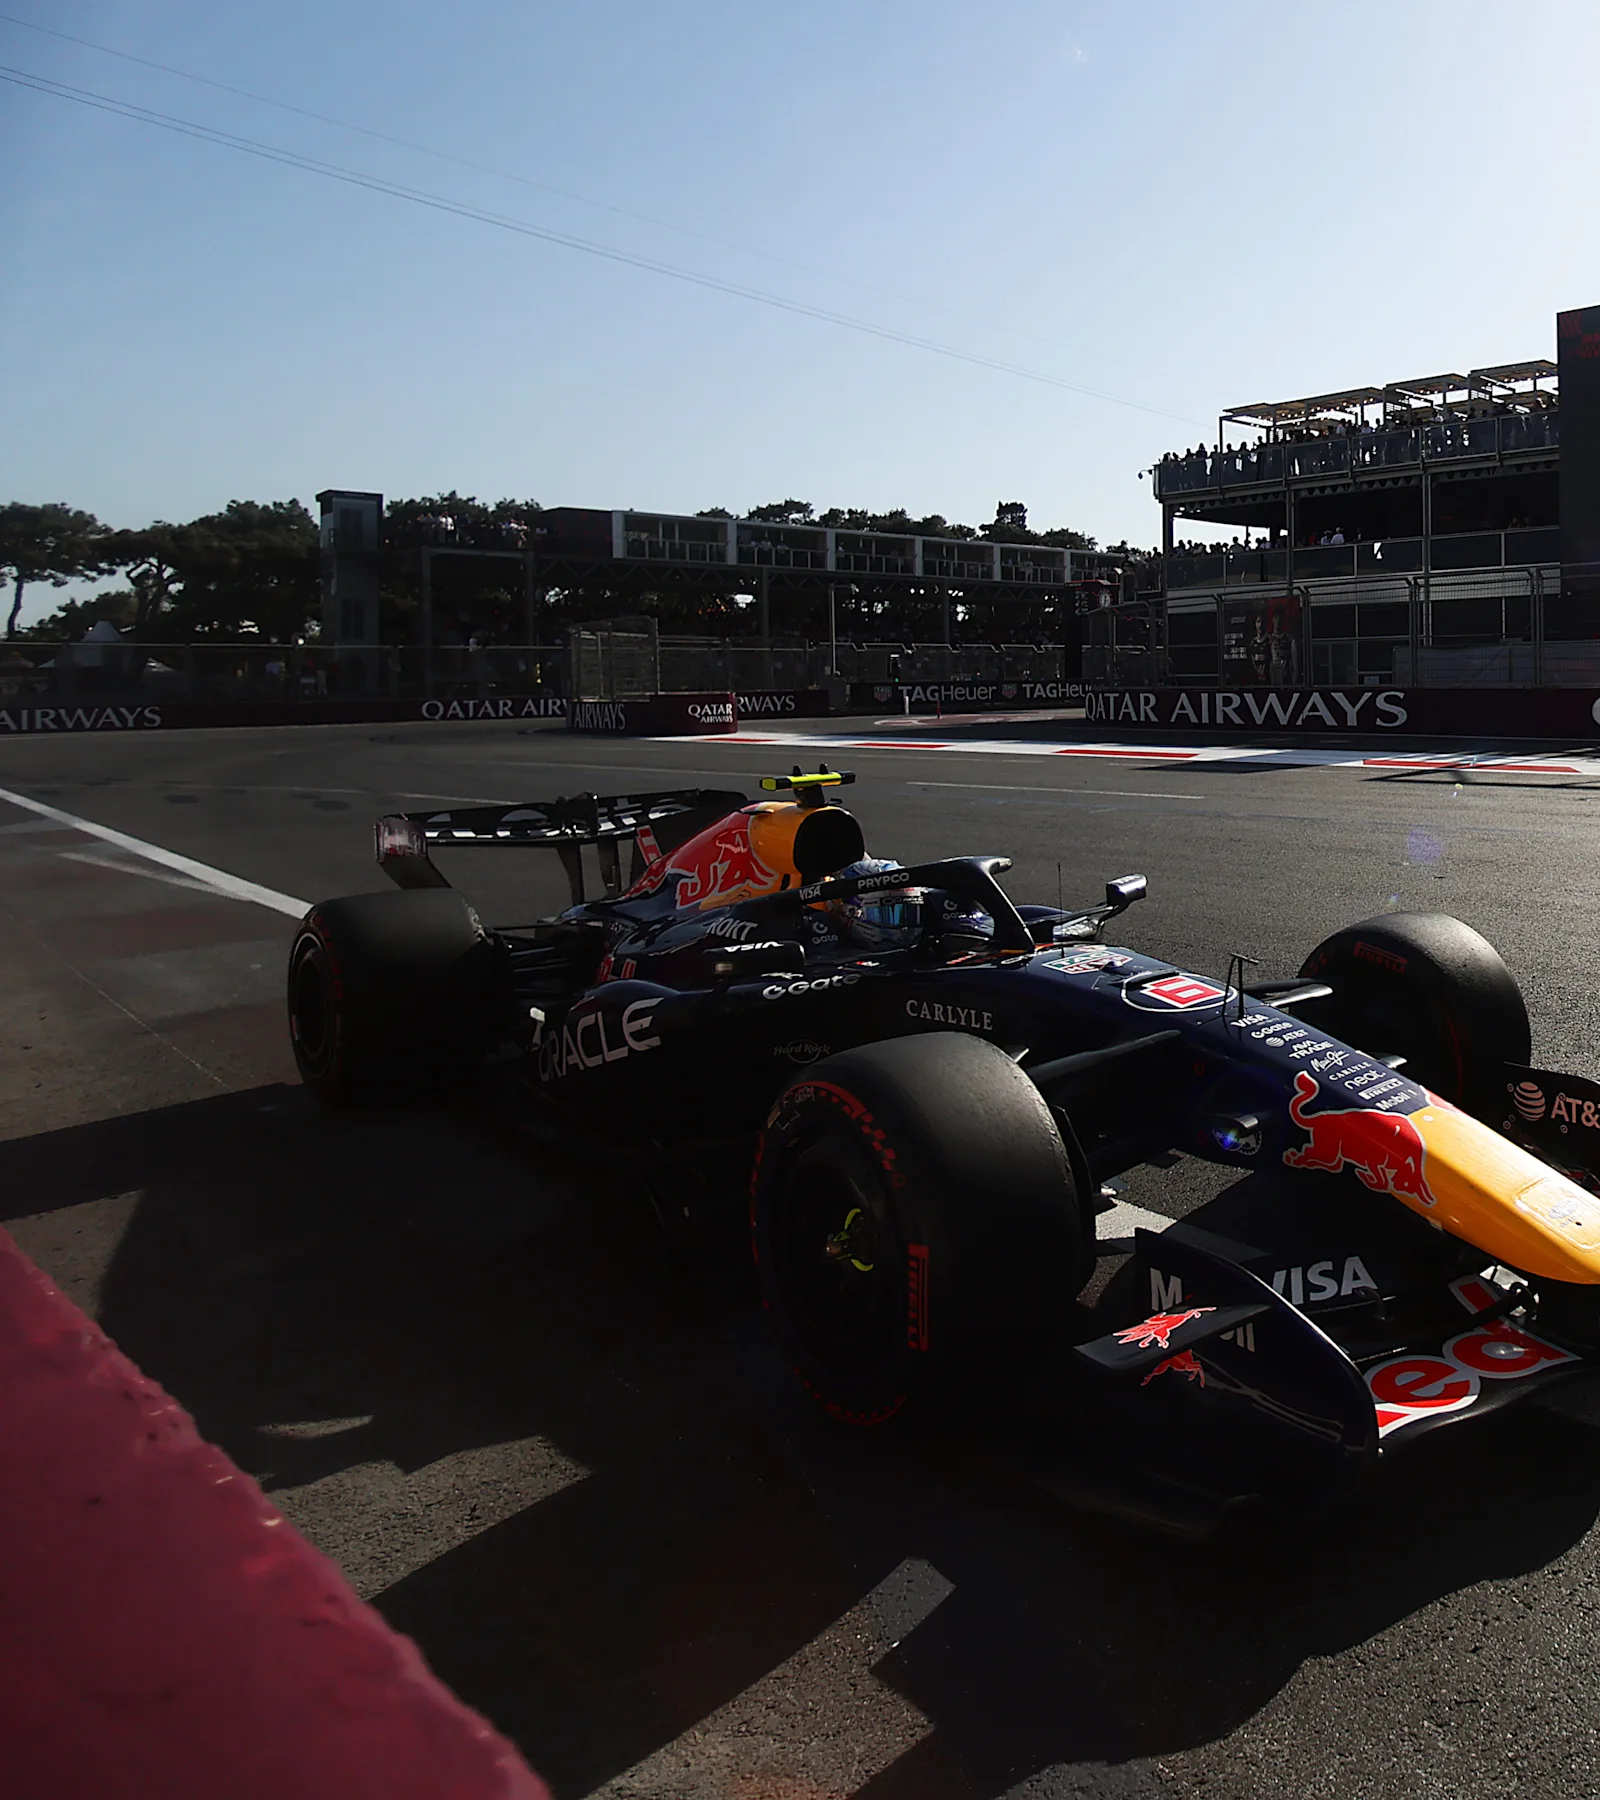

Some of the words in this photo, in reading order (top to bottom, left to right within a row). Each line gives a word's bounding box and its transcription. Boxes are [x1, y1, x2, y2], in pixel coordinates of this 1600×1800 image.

[421, 699, 515, 721] QATAR
[574, 702, 625, 730] AIRWAYS
[687, 703, 734, 719] QATAR
[1085, 691, 1159, 722] QATAR
[1170, 690, 1408, 728] AIRWAYS
[858, 873, 910, 889] PRYPCO
[799, 885, 822, 900] VISA
[1140, 976, 1227, 1009] 6
[905, 999, 994, 1031] CARLYLE
[1230, 1014, 1269, 1028] VISA
[540, 997, 666, 1082] ORACLE
[773, 1045, 802, 1056] Hard
[804, 1043, 831, 1055] Rock
[1329, 1062, 1372, 1081] CARLYLE
[1375, 1092, 1411, 1110] Mobil
